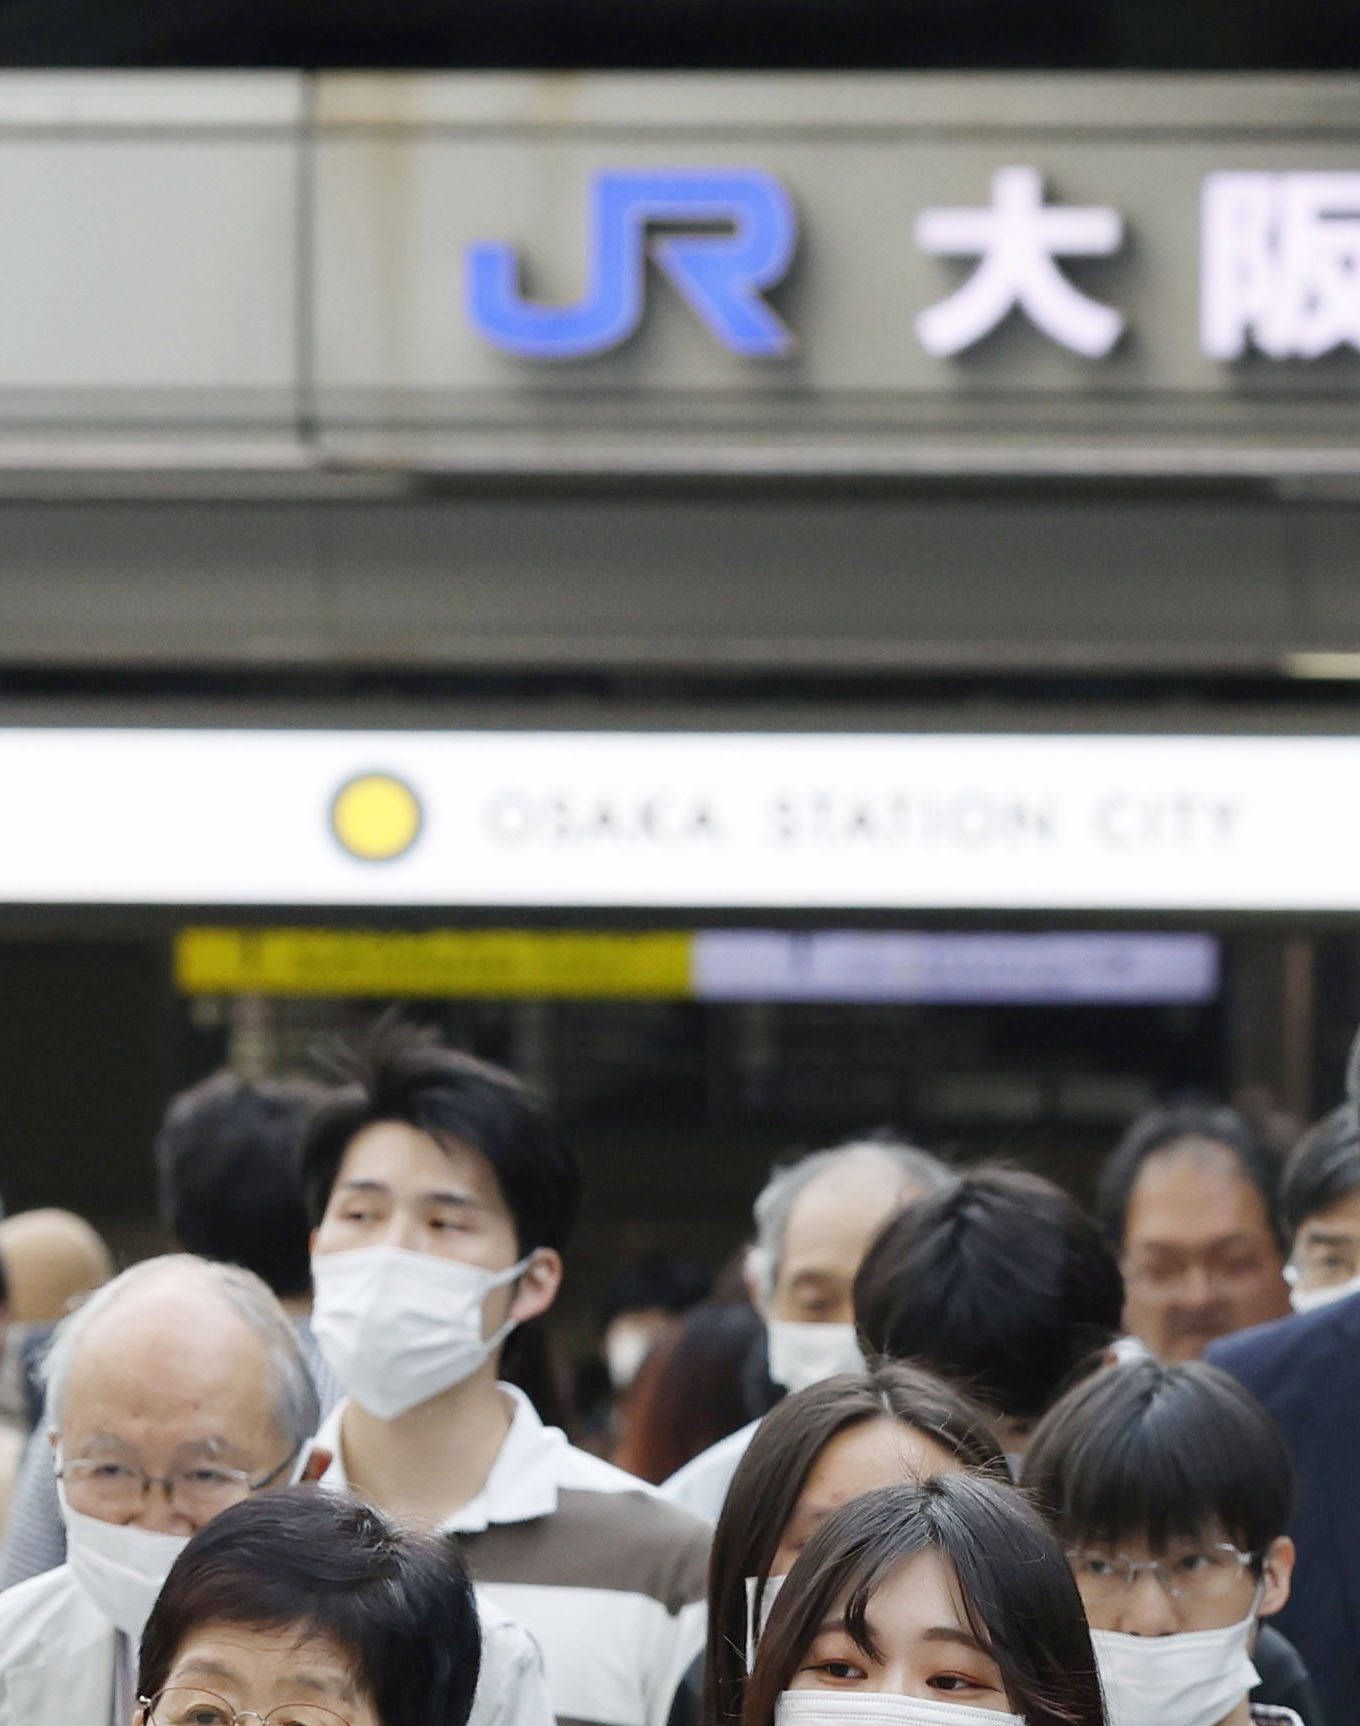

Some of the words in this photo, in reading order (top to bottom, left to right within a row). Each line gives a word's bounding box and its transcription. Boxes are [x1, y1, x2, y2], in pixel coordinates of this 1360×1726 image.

[464, 167, 797, 358] JR
[482, 789, 726, 847] OSAKA
[768, 789, 1058, 847] STATION
[1090, 789, 1244, 847] CITY
